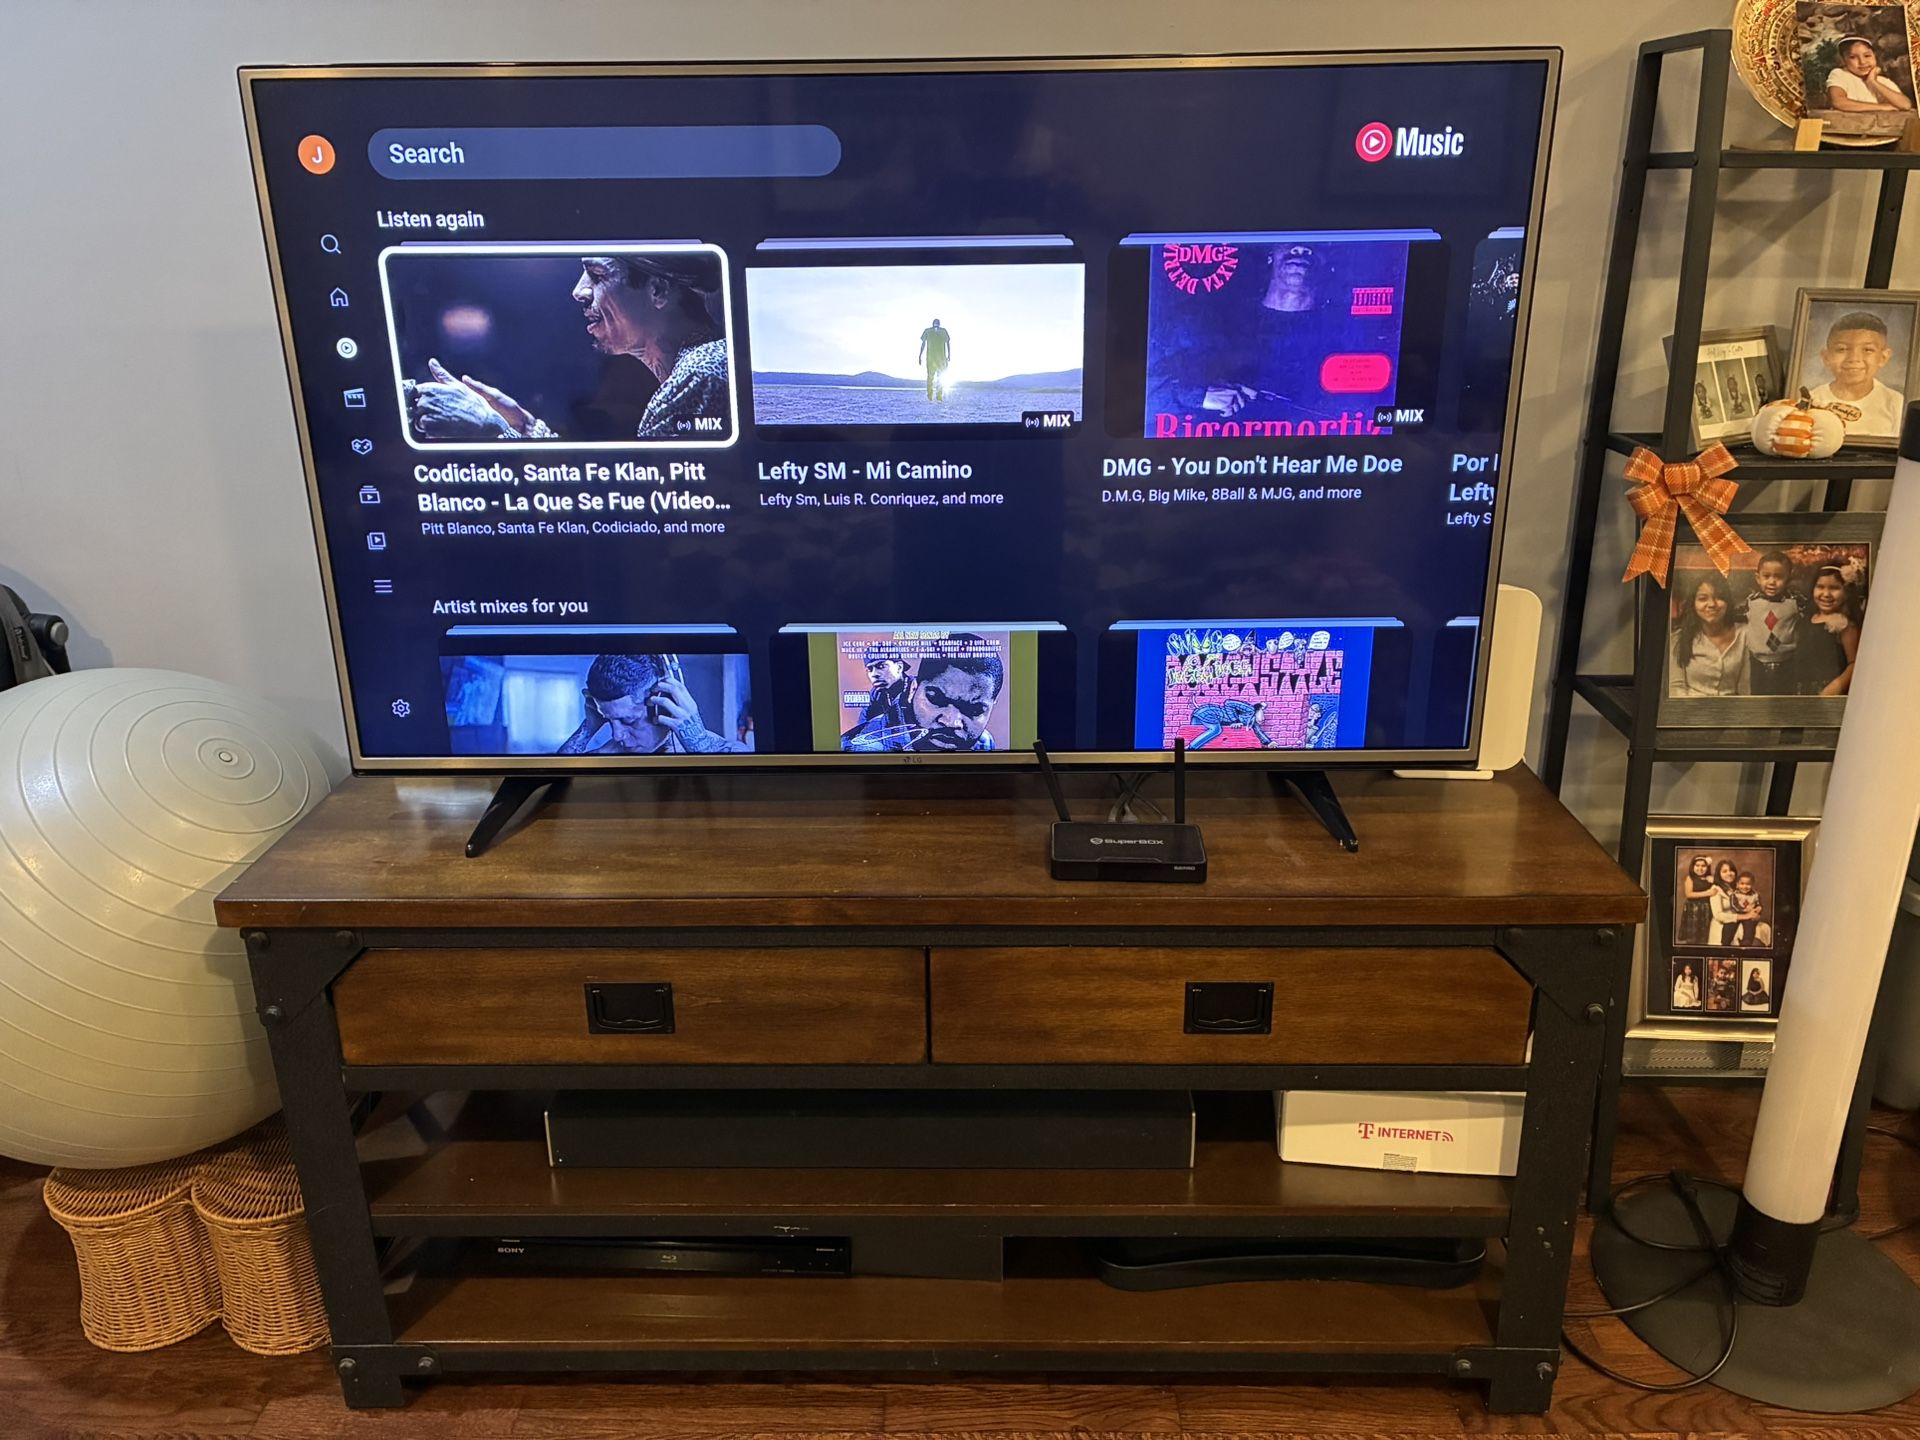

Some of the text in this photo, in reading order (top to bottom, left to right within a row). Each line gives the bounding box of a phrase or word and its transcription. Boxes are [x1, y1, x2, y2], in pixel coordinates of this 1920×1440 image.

[1396, 126, 1464, 156] Music
[312, 146, 323, 164] J
[388, 142, 465, 164] Search
[377, 210, 485, 231] Listen again
[1179, 244, 1223, 264] DMG
[694, 417, 723, 431] MIX
[1043, 414, 1071, 428] MIX
[1395, 409, 1424, 423] MIX
[1103, 458, 1151, 477] DMG
[1171, 457, 1210, 475] You
[1216, 455, 1268, 475] Don't
[1272, 455, 1321, 474] Hear
[1326, 455, 1358, 473] Me
[1363, 455, 1403, 473] Doe
[1452, 453, 1489, 472] Por
[414, 461, 706, 486] Codiciado, Santa Fe Klan, Pitt
[758, 461, 808, 485] Lefty
[814, 461, 847, 480] SM
[866, 460, 891, 479] Mi
[896, 460, 972, 480] Camino
[417, 492, 486, 512] Blanco
[504, 493, 529, 511] La
[533, 493, 573, 513] Que
[578, 492, 604, 511] Se
[608, 492, 645, 511] Fue
[760, 492, 1004, 508] Lefty Sm, Luis R. Conriquez, and more
[1102, 486, 1362, 504] D.M.G, Big Mike, 8Ball & MJG, and more
[1449, 482, 1495, 506] Lefty
[421, 521, 725, 536] Pitt Blanco, Santa Fe Klan, Codiciado, and more
[1447, 512, 1480, 527] Lefty
[433, 598, 588, 616] Artist mixes for you
[1358, 1122, 1441, 1141] T INTERNET
